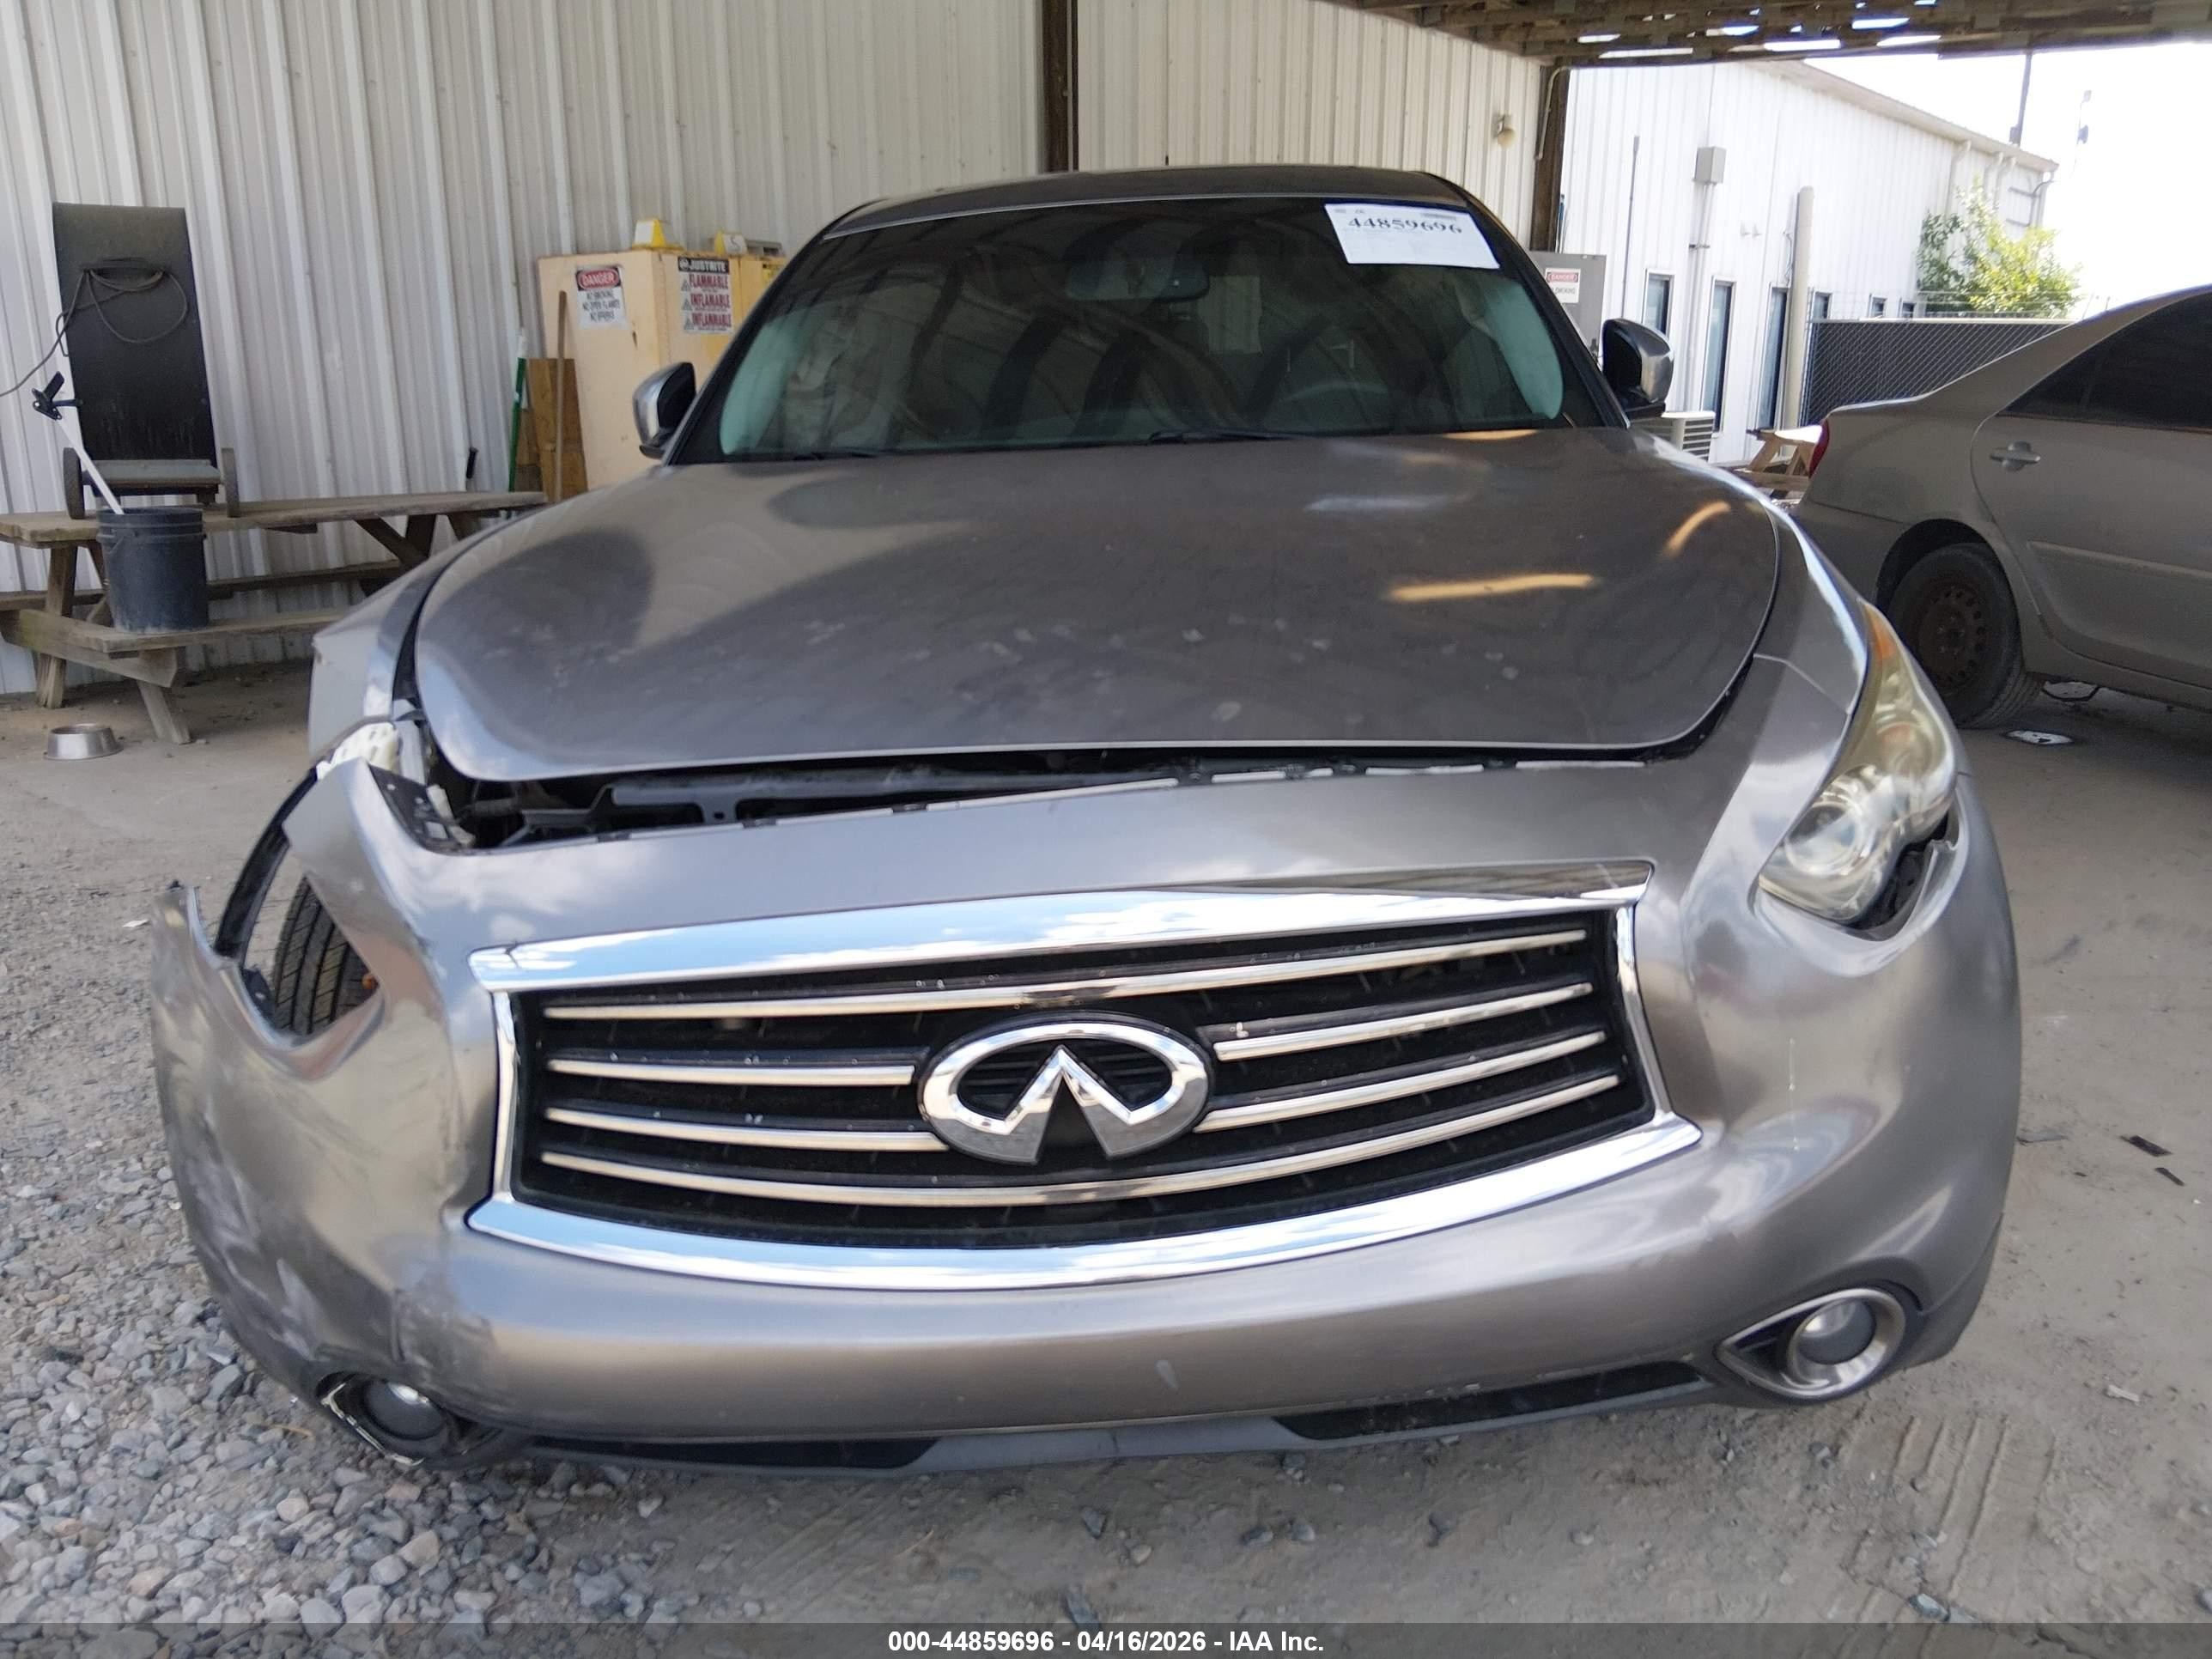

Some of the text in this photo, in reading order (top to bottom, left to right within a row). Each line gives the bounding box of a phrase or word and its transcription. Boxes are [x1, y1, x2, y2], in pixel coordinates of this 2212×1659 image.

[1348, 217, 1462, 233] 44859696
[690, 260, 726, 271] JUSTRITE
[583, 271, 614, 286] DANGER
[689, 274, 728, 289] FLAMMABLE
